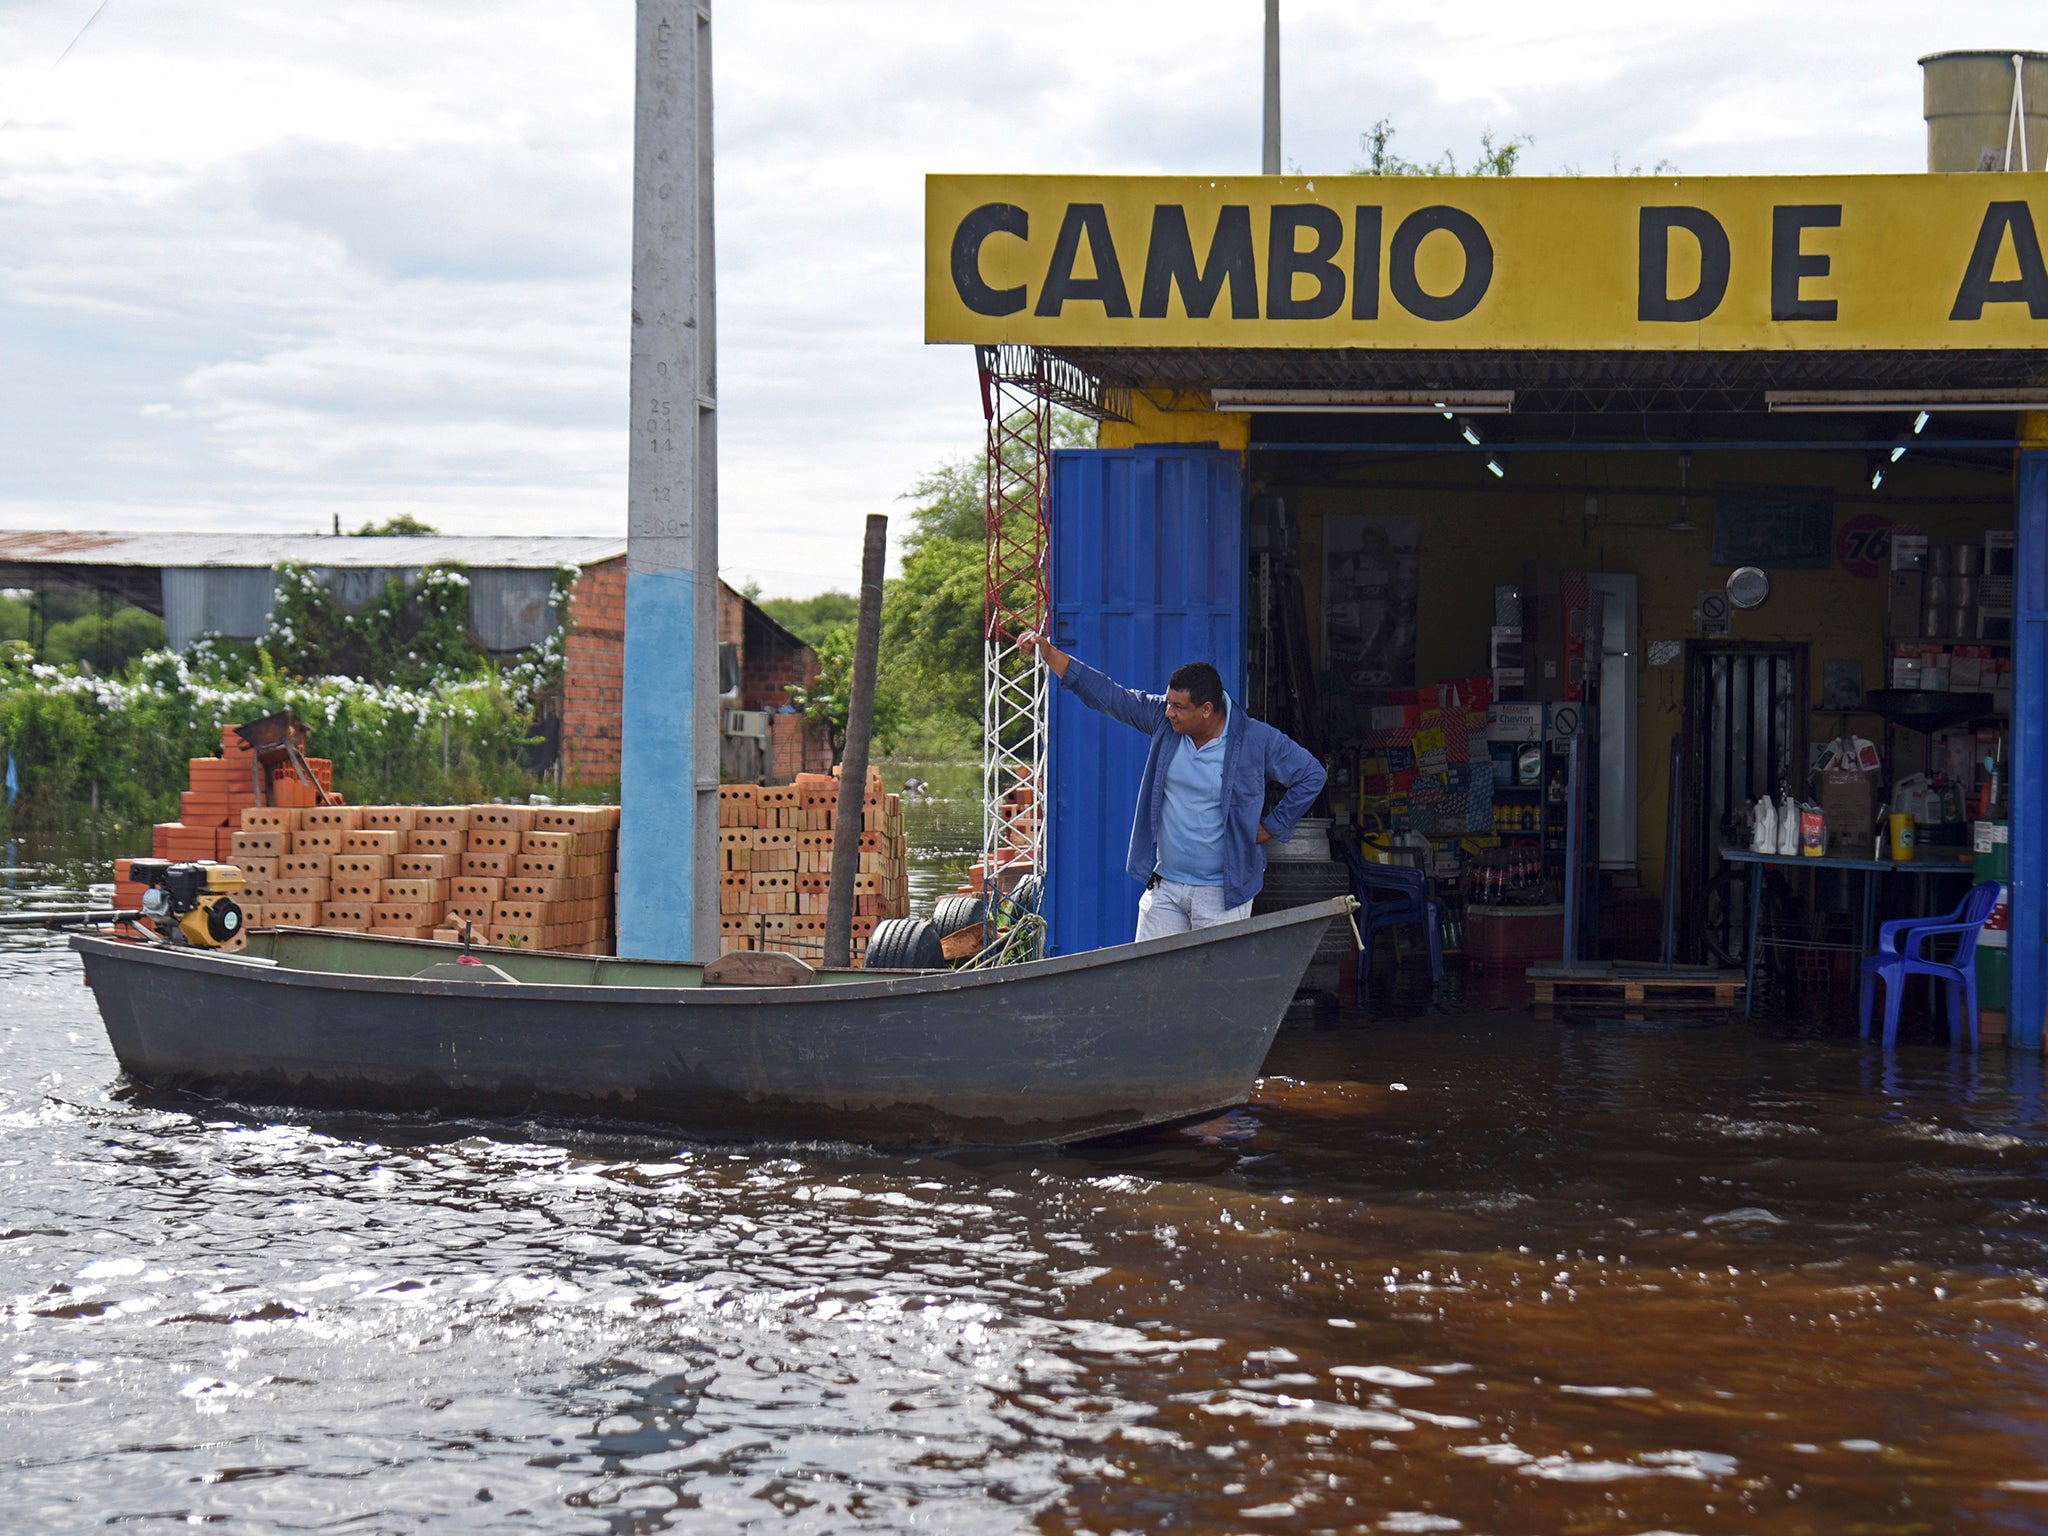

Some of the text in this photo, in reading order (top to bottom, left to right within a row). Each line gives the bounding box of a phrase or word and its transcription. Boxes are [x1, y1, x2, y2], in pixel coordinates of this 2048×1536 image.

[950, 201, 2048, 322] CAMBIO DE A
[650, 398, 671, 416] 25
[1846, 528, 1890, 562] 76
[1499, 714, 1534, 723] Chevron
